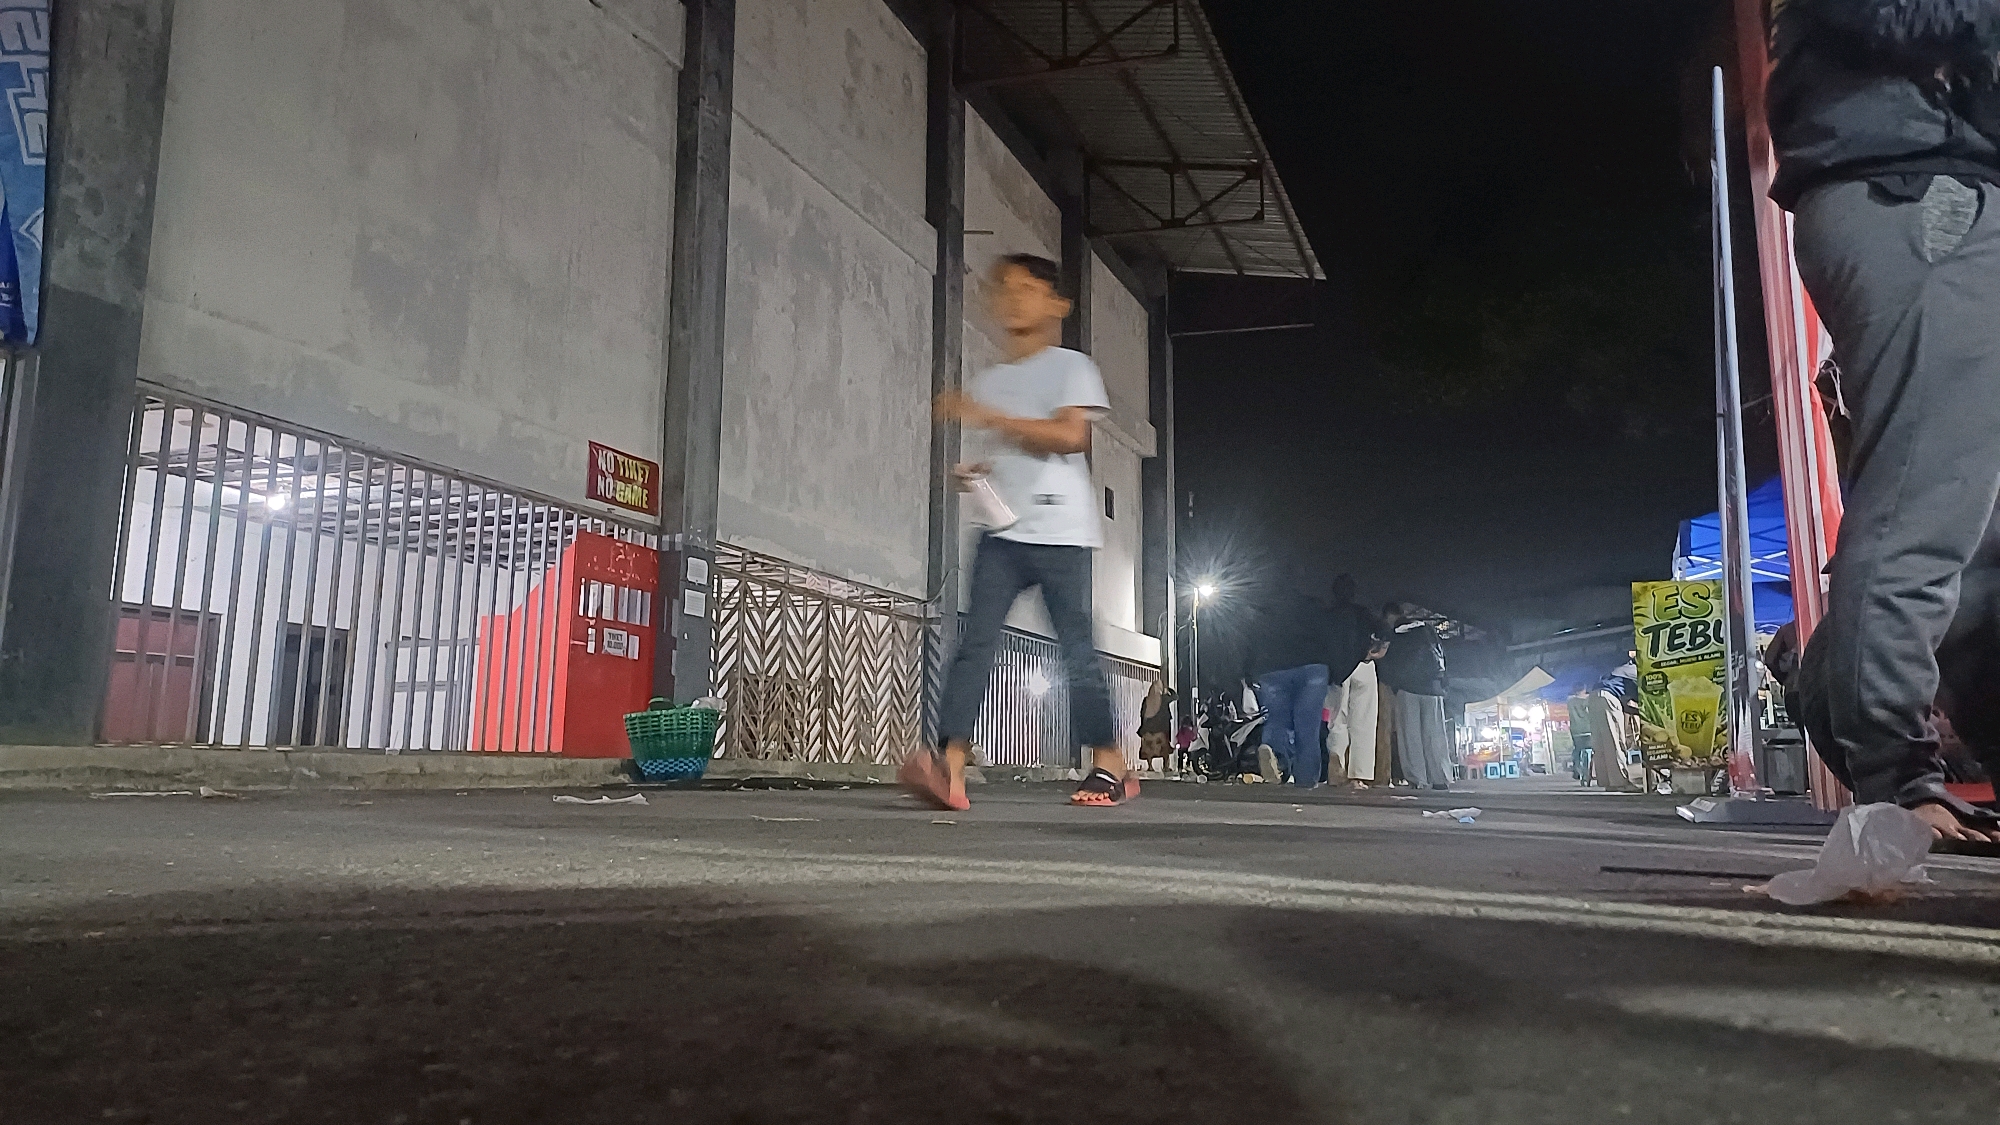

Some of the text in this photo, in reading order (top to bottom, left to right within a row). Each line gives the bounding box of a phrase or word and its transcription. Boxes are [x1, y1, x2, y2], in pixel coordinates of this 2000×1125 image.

[597, 449, 615, 474] NO
[597, 474, 649, 509] NO GAME
[1651, 583, 1714, 622] ES
